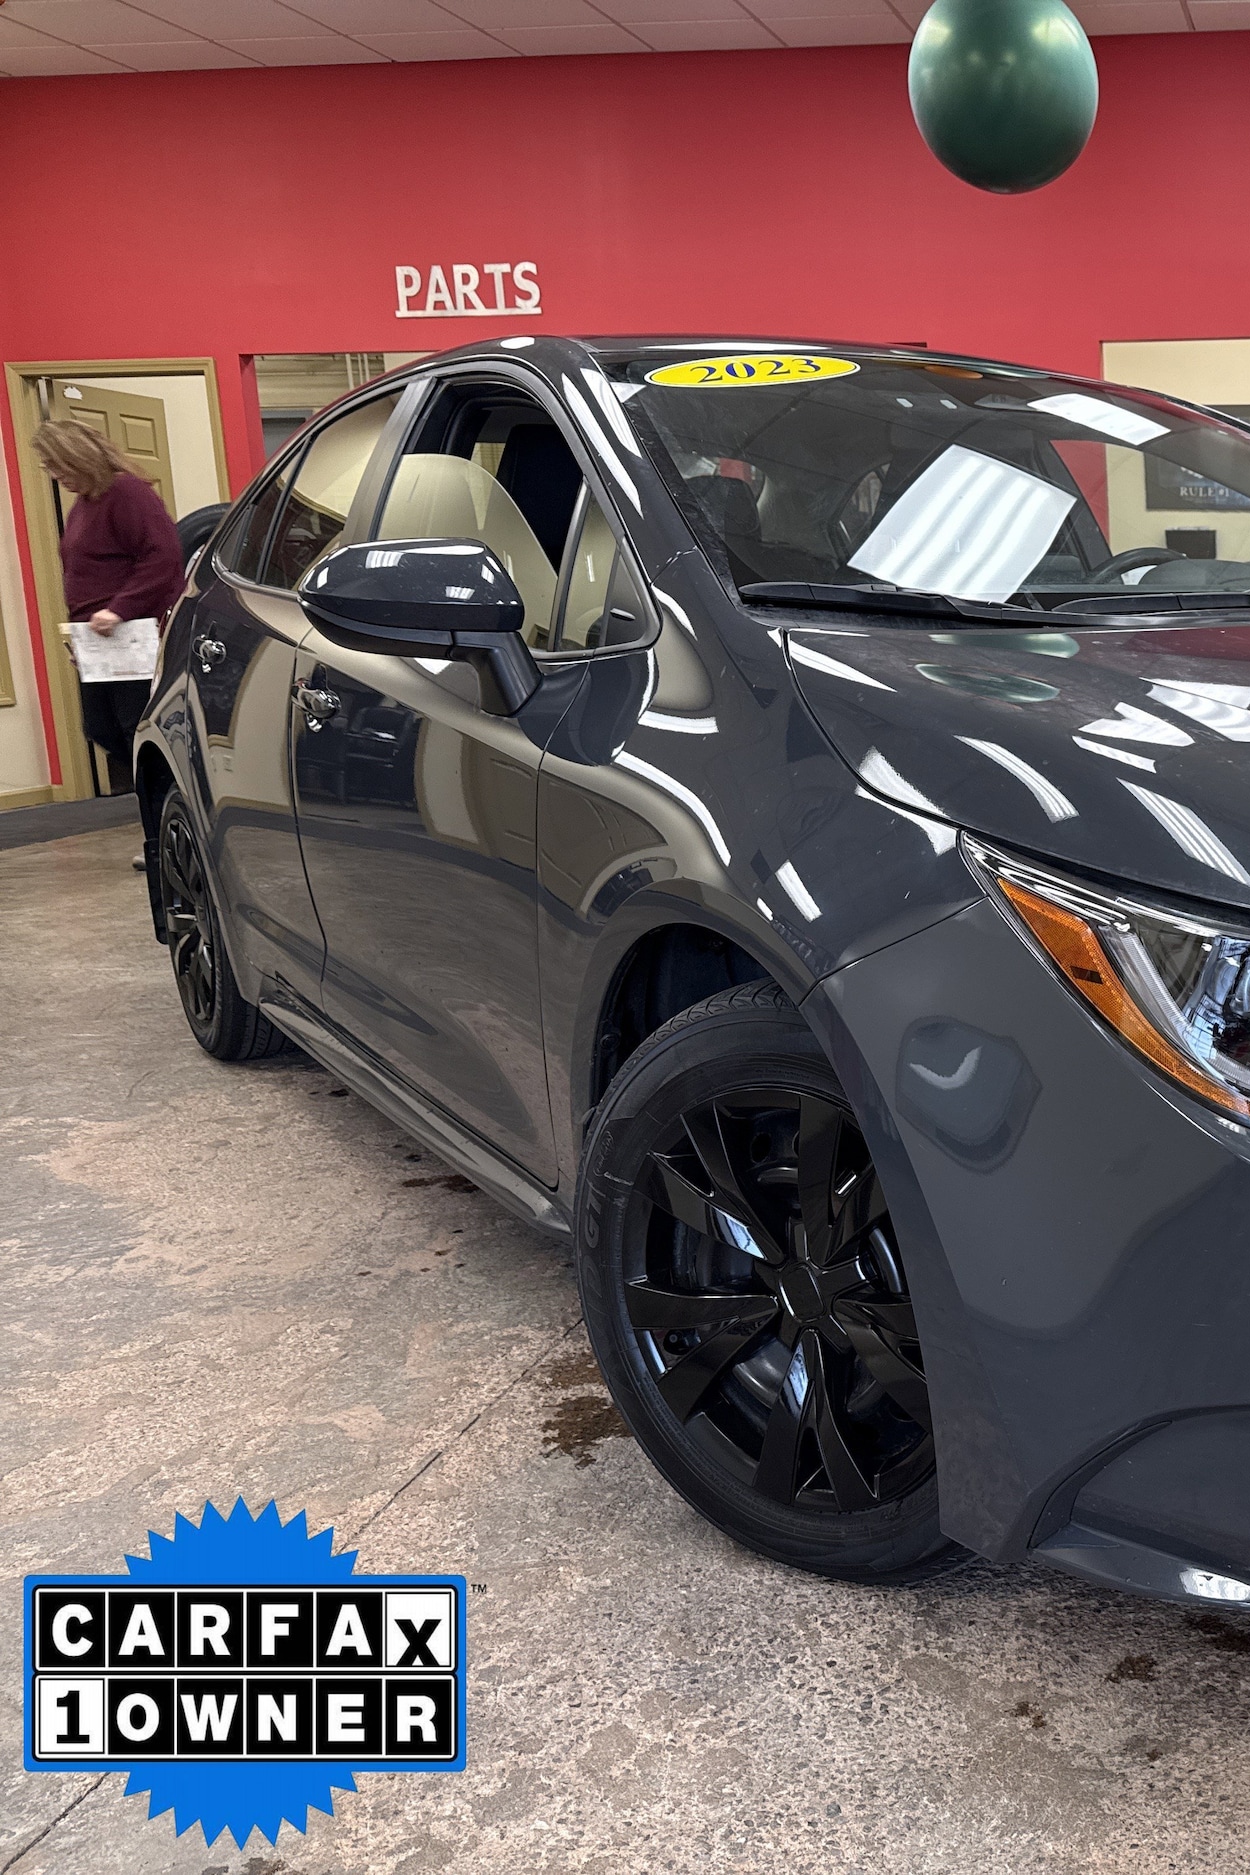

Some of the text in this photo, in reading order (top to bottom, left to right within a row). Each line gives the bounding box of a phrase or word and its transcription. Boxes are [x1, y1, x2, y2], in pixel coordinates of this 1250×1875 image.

[395, 260, 542, 312] PARTS
[690, 358, 821, 384] 2023
[1180, 486, 1216, 497] RULE
